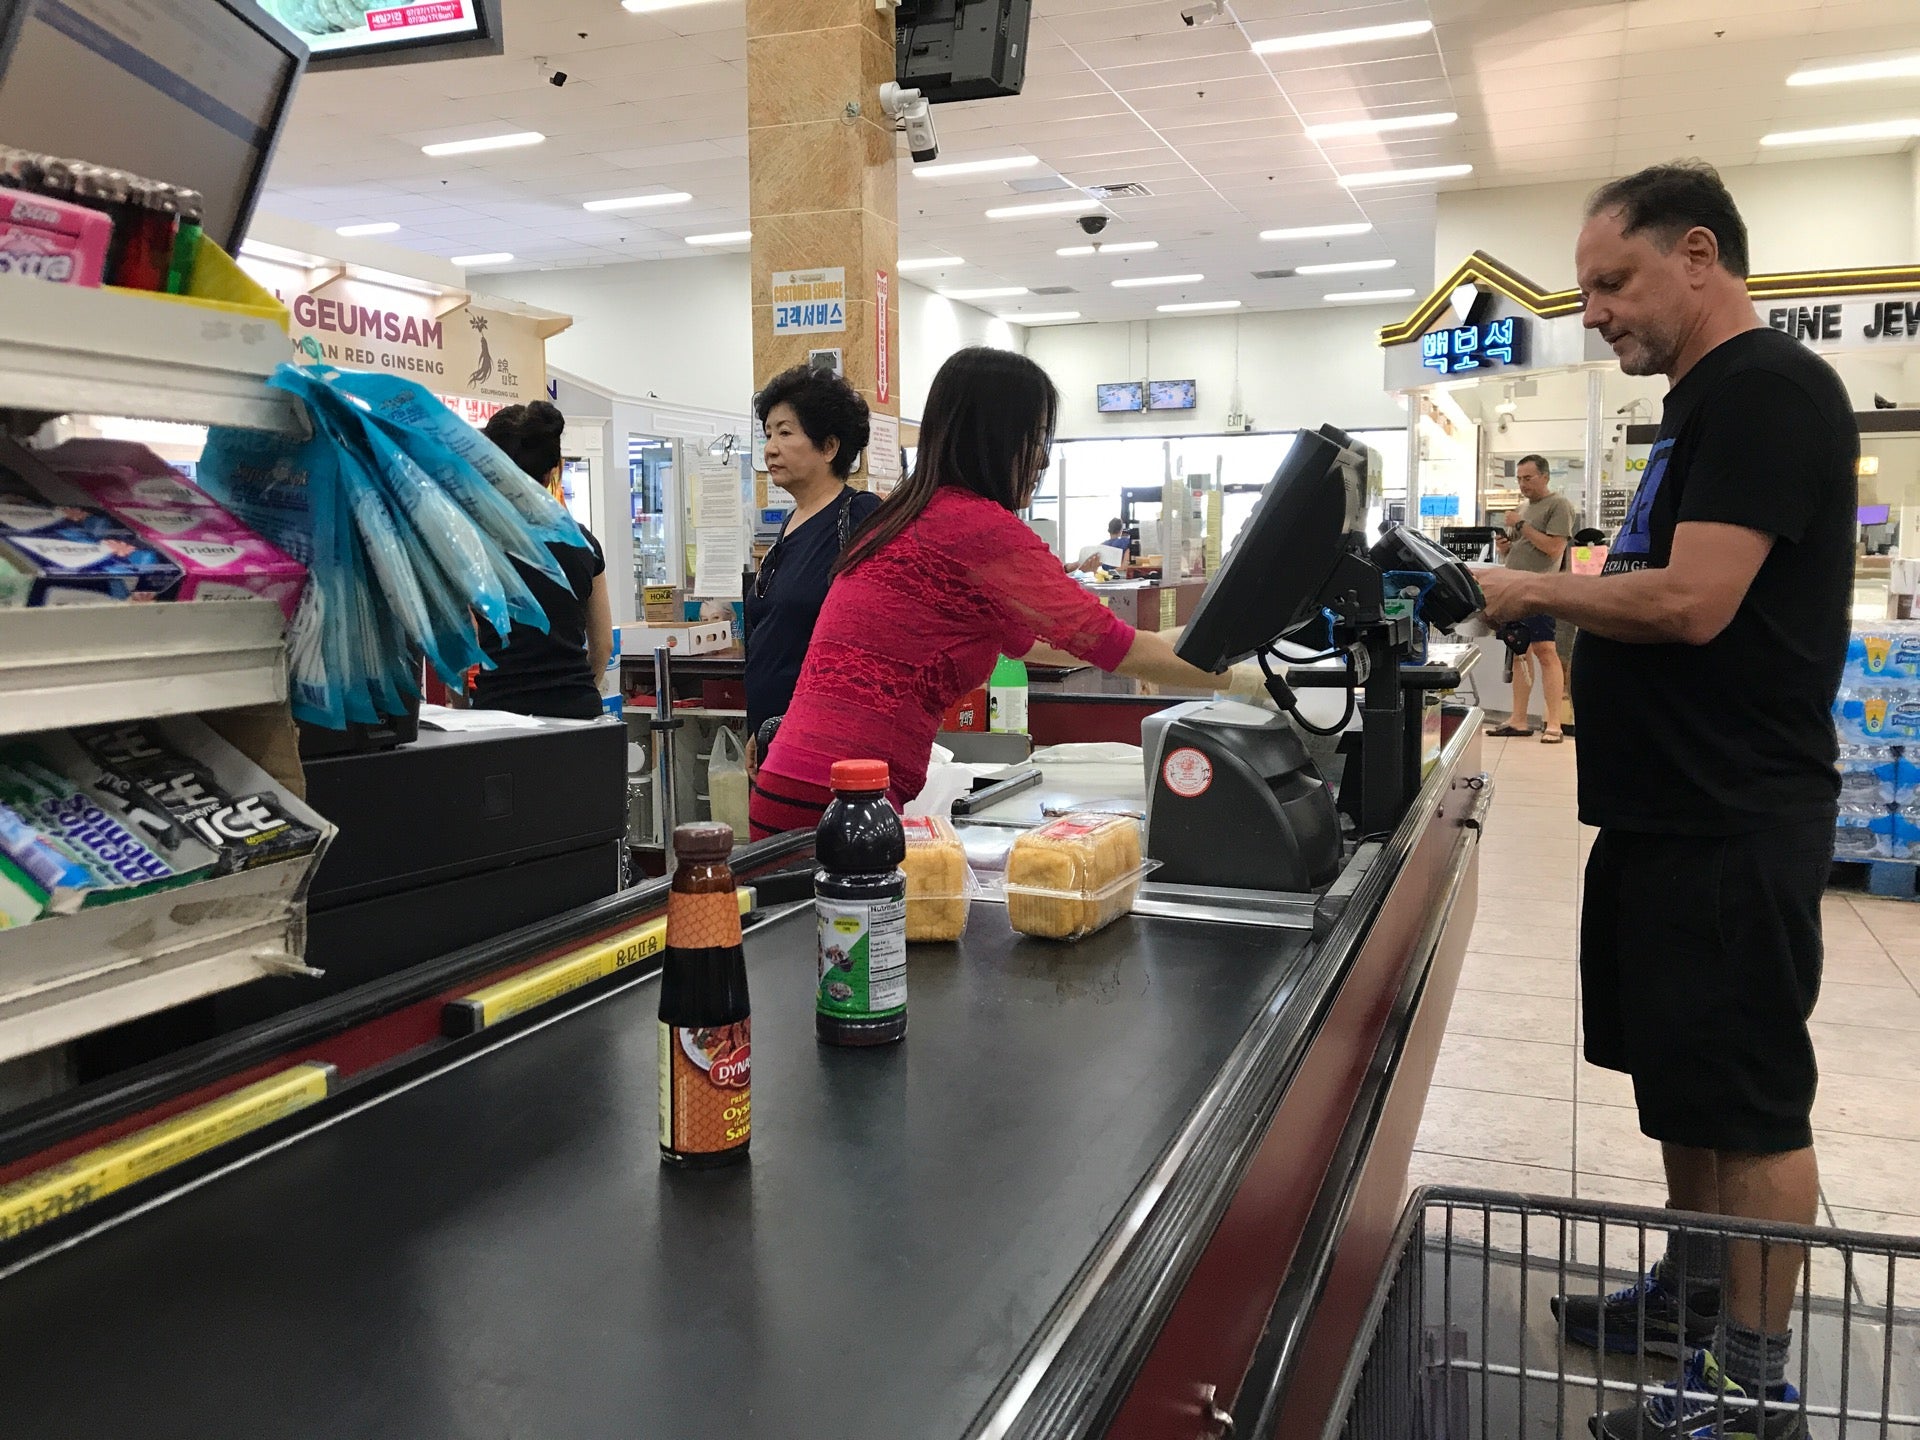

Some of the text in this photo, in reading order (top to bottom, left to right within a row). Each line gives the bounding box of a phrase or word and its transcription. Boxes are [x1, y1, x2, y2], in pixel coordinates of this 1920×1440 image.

[774, 281, 843, 302] CUSTOMER SERVICE
[293, 294, 443, 350] GEUMSAM
[776, 303, 843, 328] 고객서비스
[1769, 303, 1842, 341] FINE
[1422, 317, 1514, 375] 백보석
[345, 348, 375, 364] RED
[381, 354, 444, 376] GINSENG
[1227, 414, 1243, 427] EXIT
[138, 512, 194, 526] Trident
[181, 543, 237, 557] Trident
[175, 802, 222, 823] Dentyne
[195, 796, 286, 846] ICE
[870, 902, 896, 913] Nutrition
